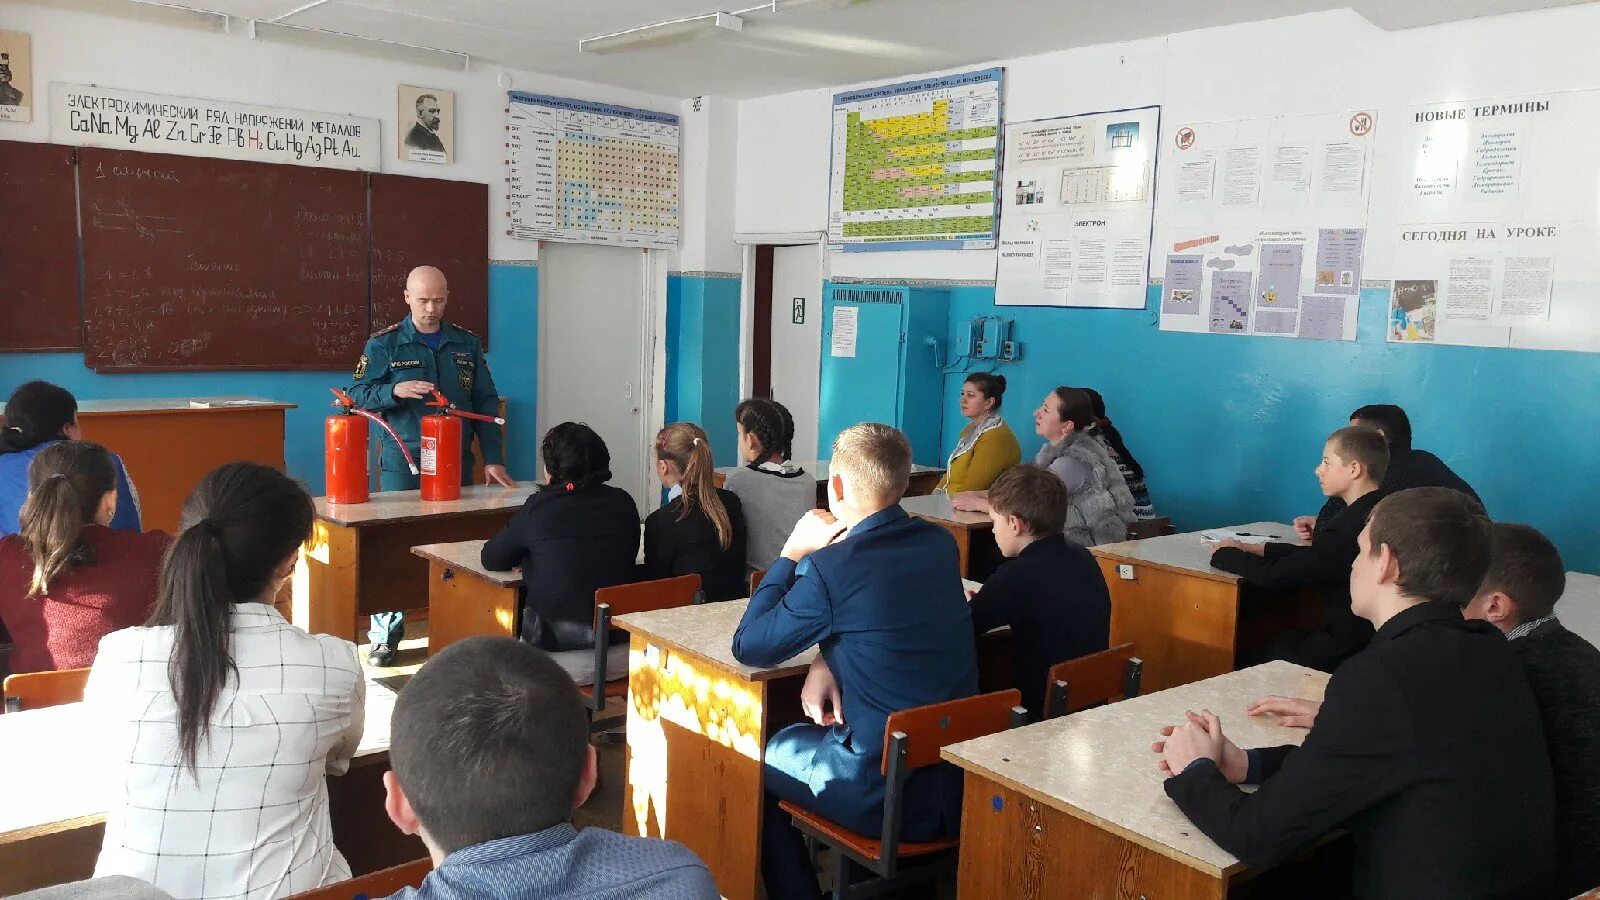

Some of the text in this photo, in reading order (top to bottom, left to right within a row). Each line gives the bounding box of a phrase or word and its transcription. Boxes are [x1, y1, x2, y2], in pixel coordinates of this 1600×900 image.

[68, 93, 199, 120] ЭЛЕКТРОХИМИЧЕСКИЙ
[235, 111, 304, 132] НАПРЯЖЕНИЙ
[311, 121, 361, 138] МЕТАЛЛОВ
[1415, 100, 1550, 123] НОВЫЕ ТЕРМИНЫ
[115, 115, 139, 144] Mg
[142, 118, 161, 139] Al
[165, 120, 187, 141] Zn
[190, 123, 206, 144] Cr
[266, 131, 285, 151] Cu
[286, 133, 303, 160] Hg
[304, 135, 323, 162] Ag
[323, 136, 339, 156] Pt
[342, 139, 361, 158] Au
[1401, 226, 1557, 243] СЕГОДНЯ НА УРОКЕ
